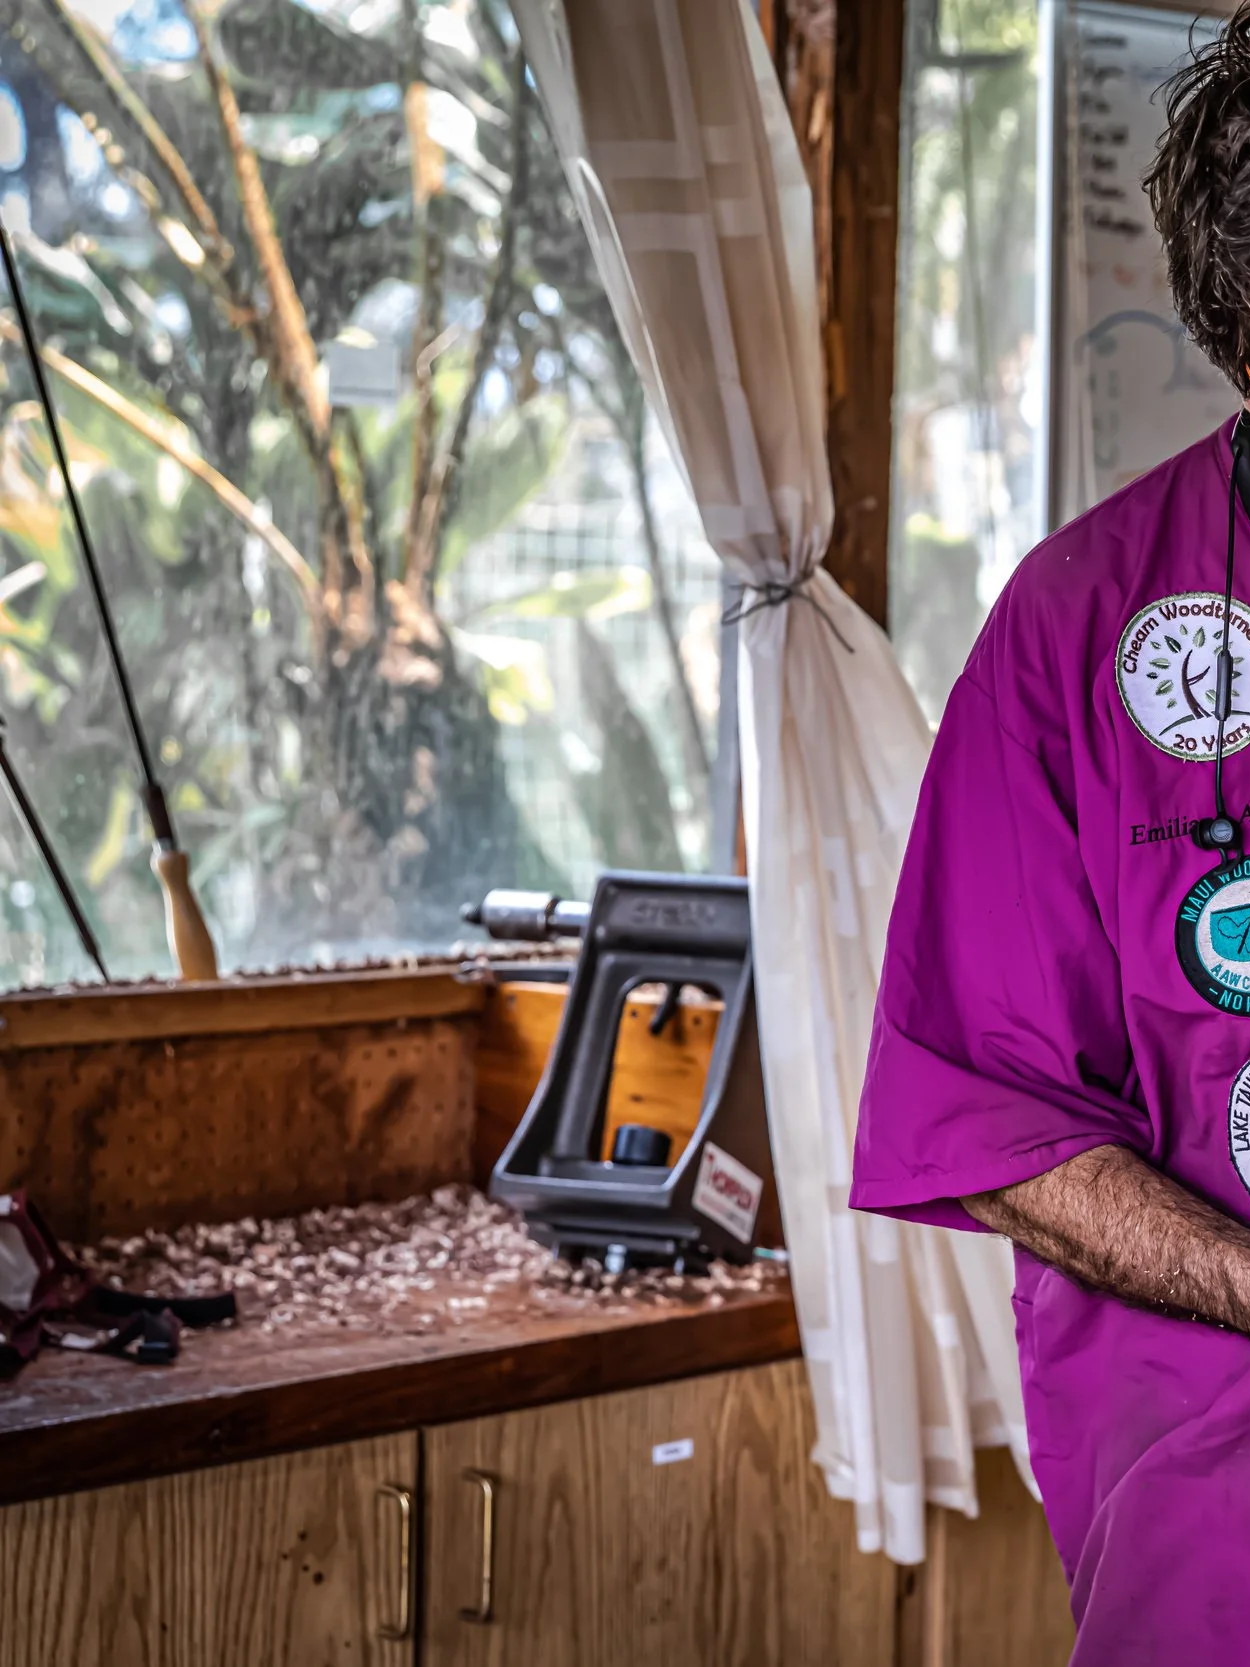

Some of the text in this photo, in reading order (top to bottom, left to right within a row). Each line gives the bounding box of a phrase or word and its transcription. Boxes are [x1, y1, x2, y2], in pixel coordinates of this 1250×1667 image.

[1123, 617, 1159, 674] Cheam
[1173, 734, 1197, 751] 20
[1181, 879, 1215, 922] MAUI
[1233, 1110, 1250, 1152] LAKE
